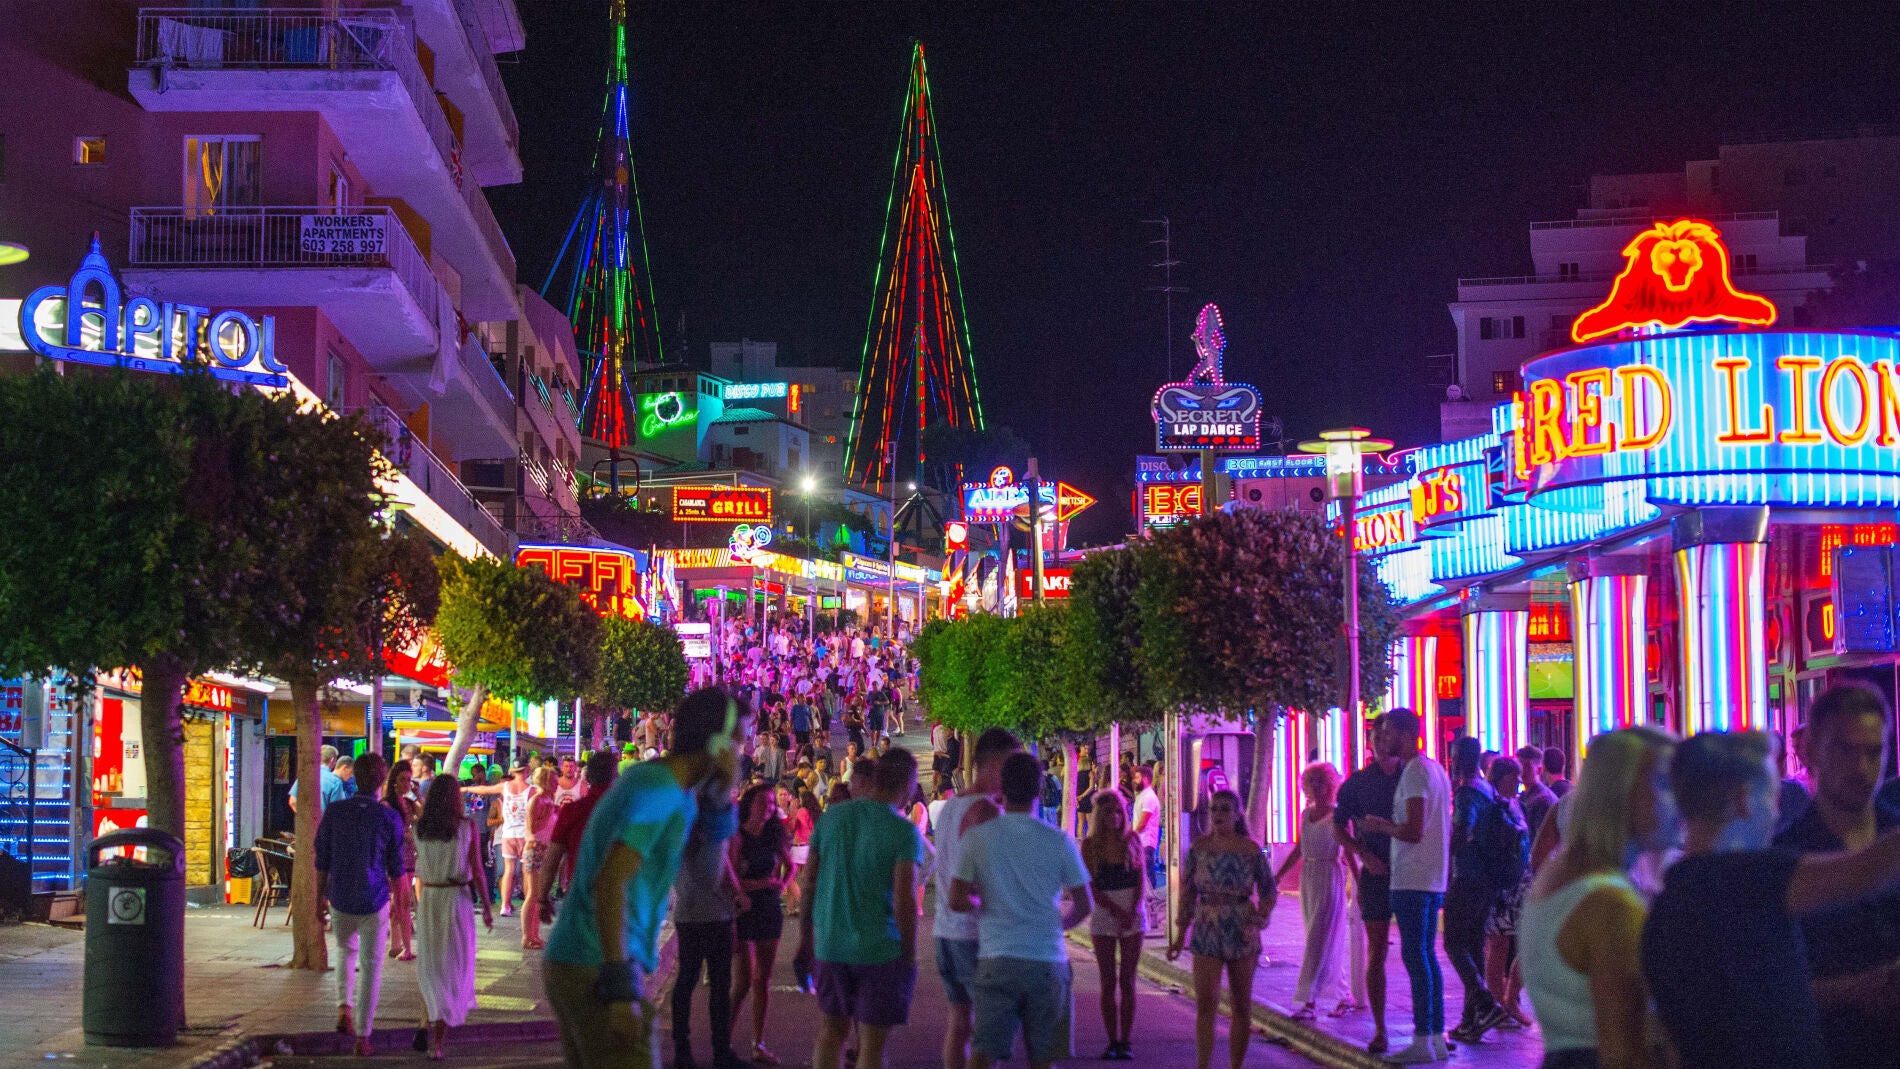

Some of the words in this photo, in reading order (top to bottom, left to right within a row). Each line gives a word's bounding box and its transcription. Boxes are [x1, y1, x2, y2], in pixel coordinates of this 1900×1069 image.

[314, 216, 374, 227] WORKERS
[303, 228, 384, 239] APARTMENTS
[303, 239, 325, 251] 603
[332, 240, 354, 253] 258
[360, 240, 383, 253] 997
[19, 262, 289, 387] CAPITOL
[1163, 401, 1255, 424] SECRETS
[1531, 364, 1672, 465] RED
[1174, 424, 1197, 435] LAP
[1201, 424, 1242, 435] DANCE
[1140, 462, 1171, 471] DISC
[1259, 459, 1283, 467] FIRST
[1149, 485, 1203, 515] BC
[712, 501, 764, 515] GRILL
